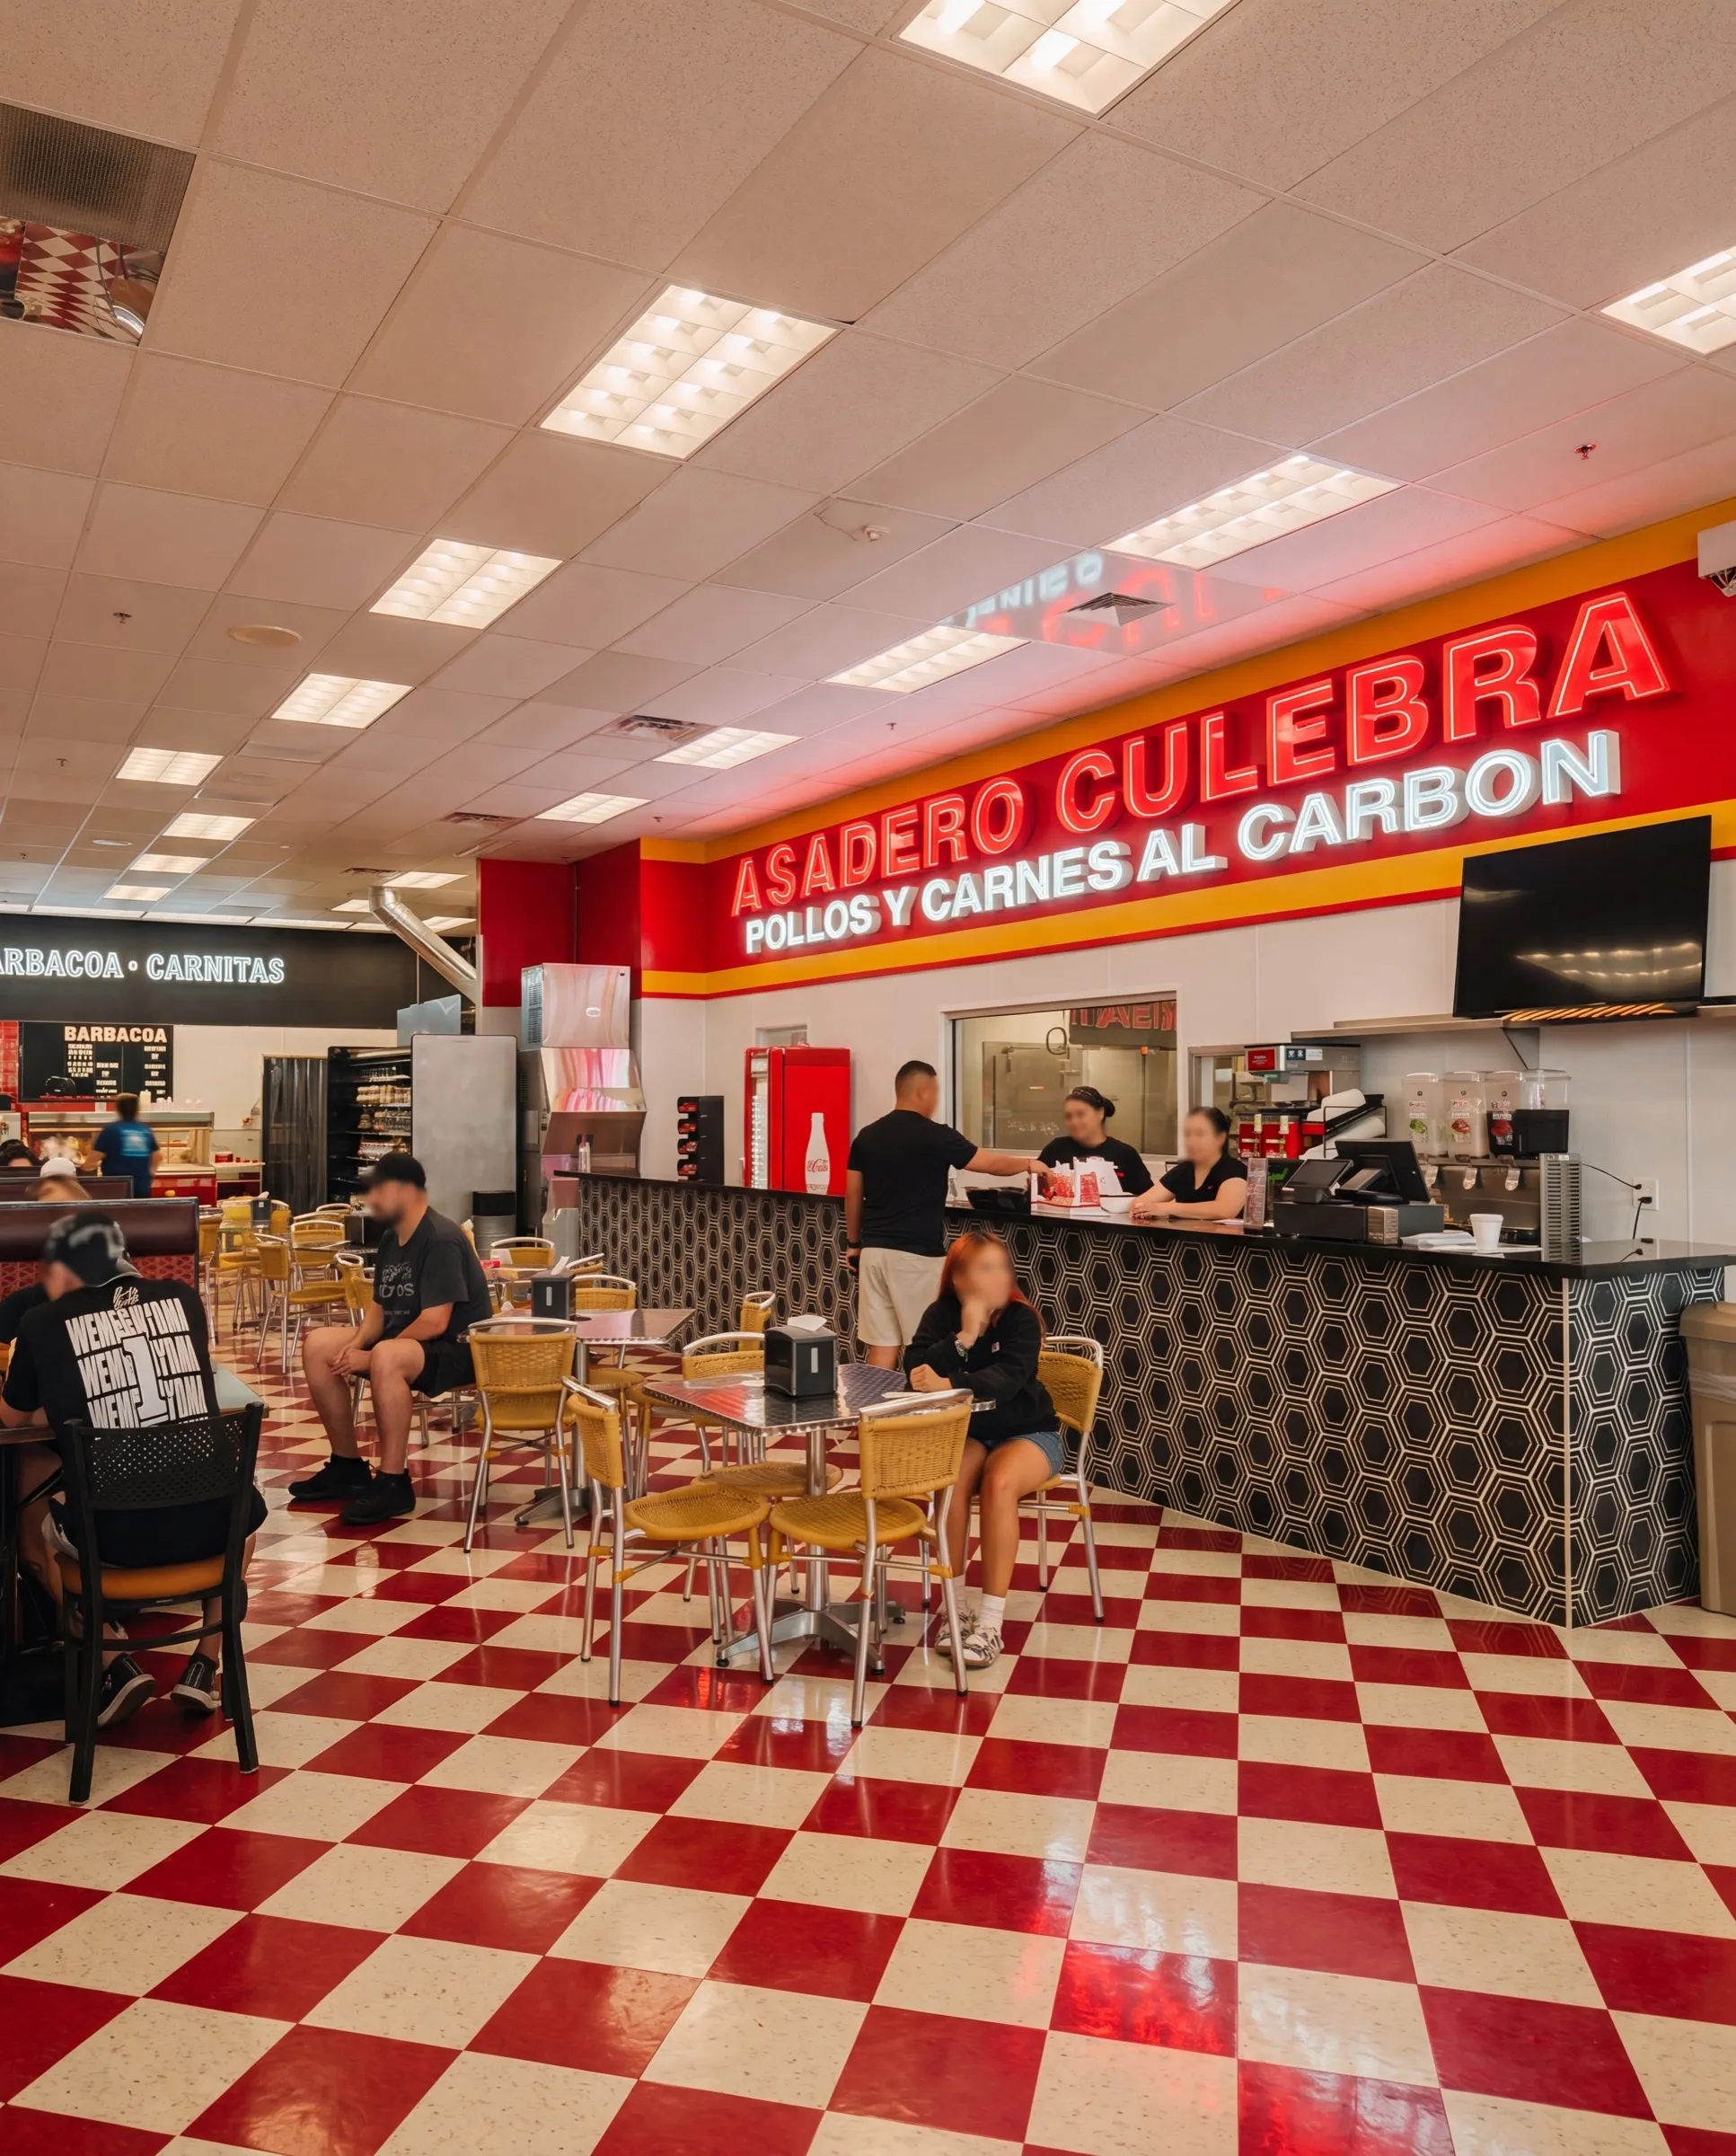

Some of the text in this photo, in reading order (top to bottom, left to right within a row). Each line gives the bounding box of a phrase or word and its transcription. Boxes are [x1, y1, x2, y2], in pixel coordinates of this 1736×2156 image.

[731, 776, 1026, 917] ASADERO
[1055, 591, 1673, 834] CULEBRA
[746, 729, 1620, 954] POLLOS Y CARNES AL CARBON
[0, 948, 285, 984] RBACOA CARNITAS
[64, 1026, 168, 1043] BARBACOA
